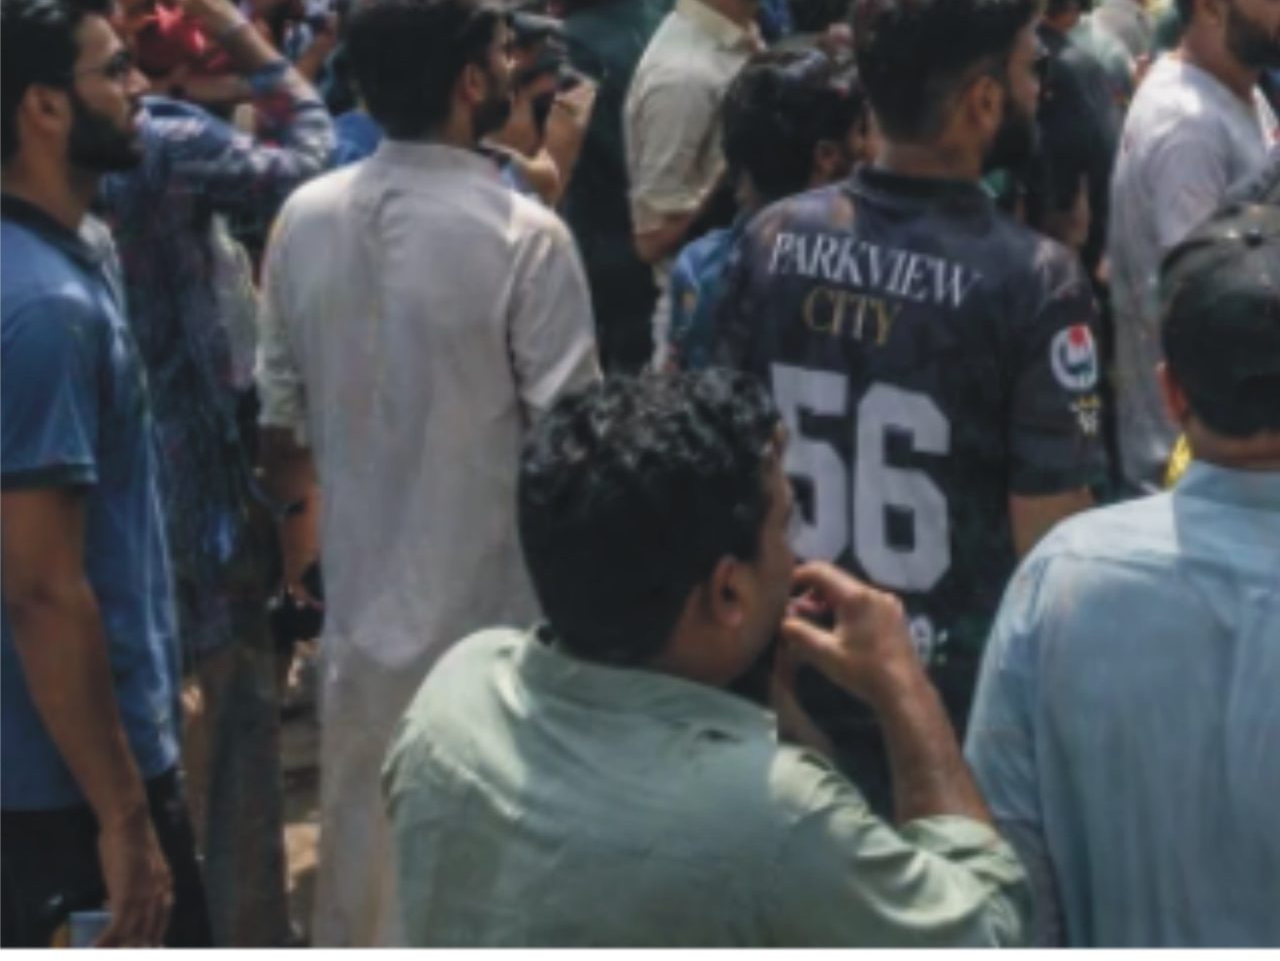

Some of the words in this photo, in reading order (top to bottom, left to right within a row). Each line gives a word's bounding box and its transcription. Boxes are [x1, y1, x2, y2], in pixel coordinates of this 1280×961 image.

[769, 233, 981, 308] PARKVIEW
[804, 286, 901, 346] CITY
[769, 362, 952, 595] 56
